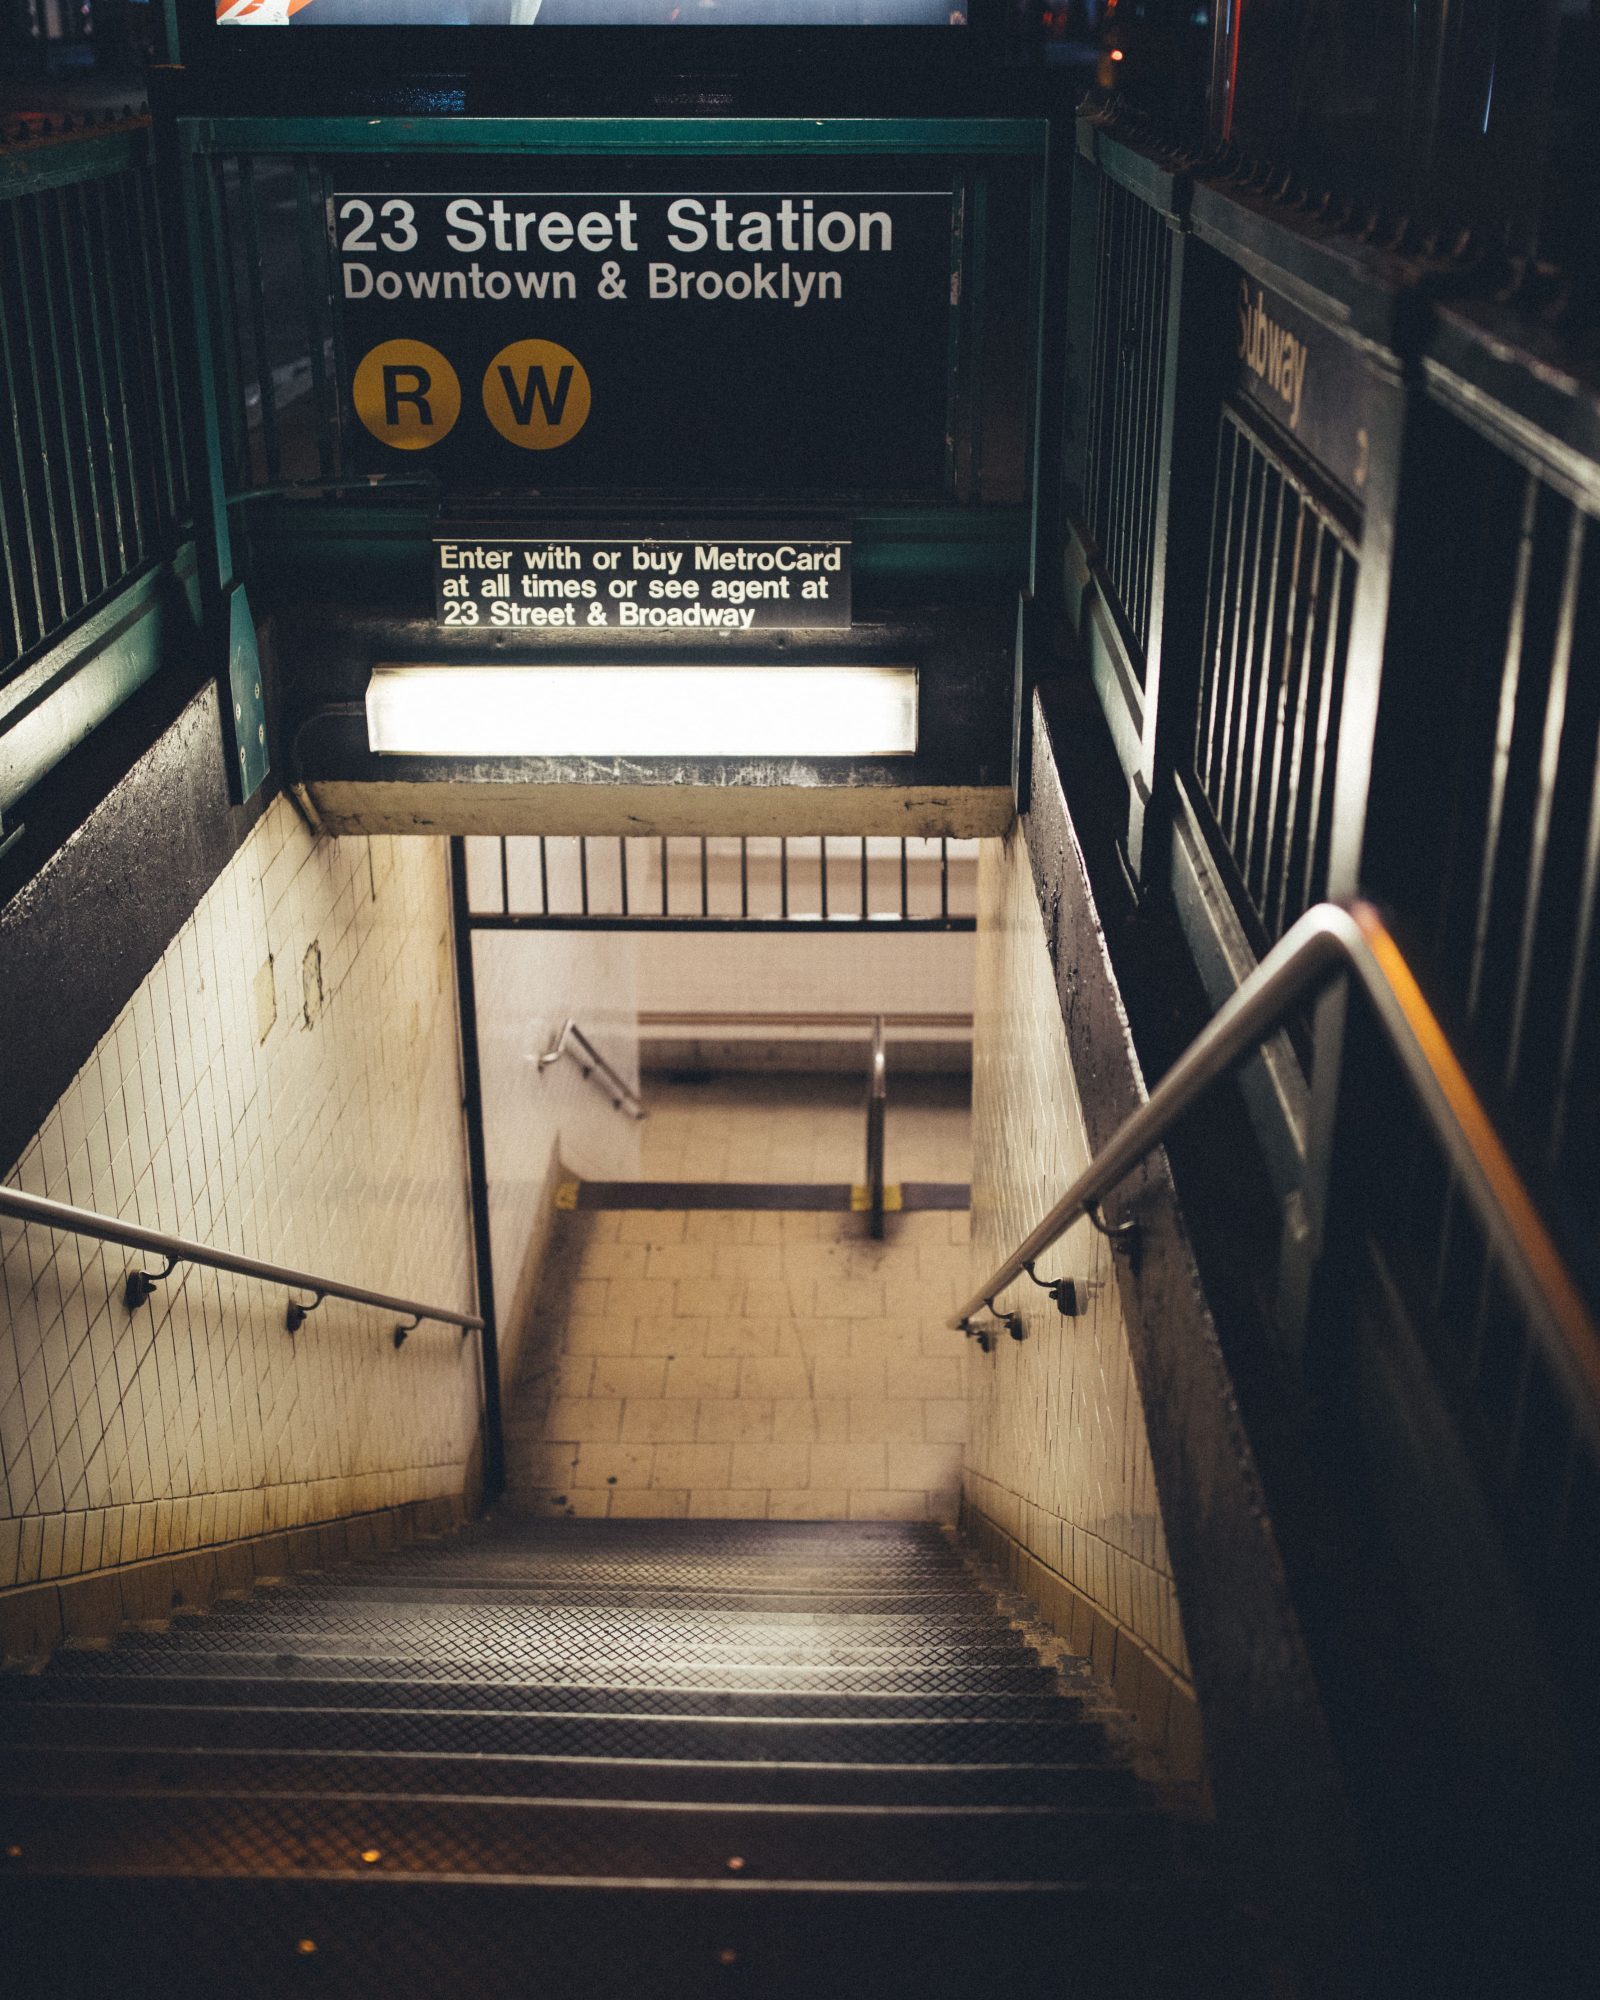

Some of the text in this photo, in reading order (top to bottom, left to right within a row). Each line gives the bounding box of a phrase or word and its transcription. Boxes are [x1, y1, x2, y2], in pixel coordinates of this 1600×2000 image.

[340, 198, 892, 253] 23 Street Station
[343, 260, 842, 307] Downtown & Brooklyn
[383, 365, 574, 425] R W
[440, 544, 841, 574] Enter with or buy MetroCard
[442, 573, 829, 603] at all times or see agent at
[443, 600, 756, 628] 23 Street & Broadway
